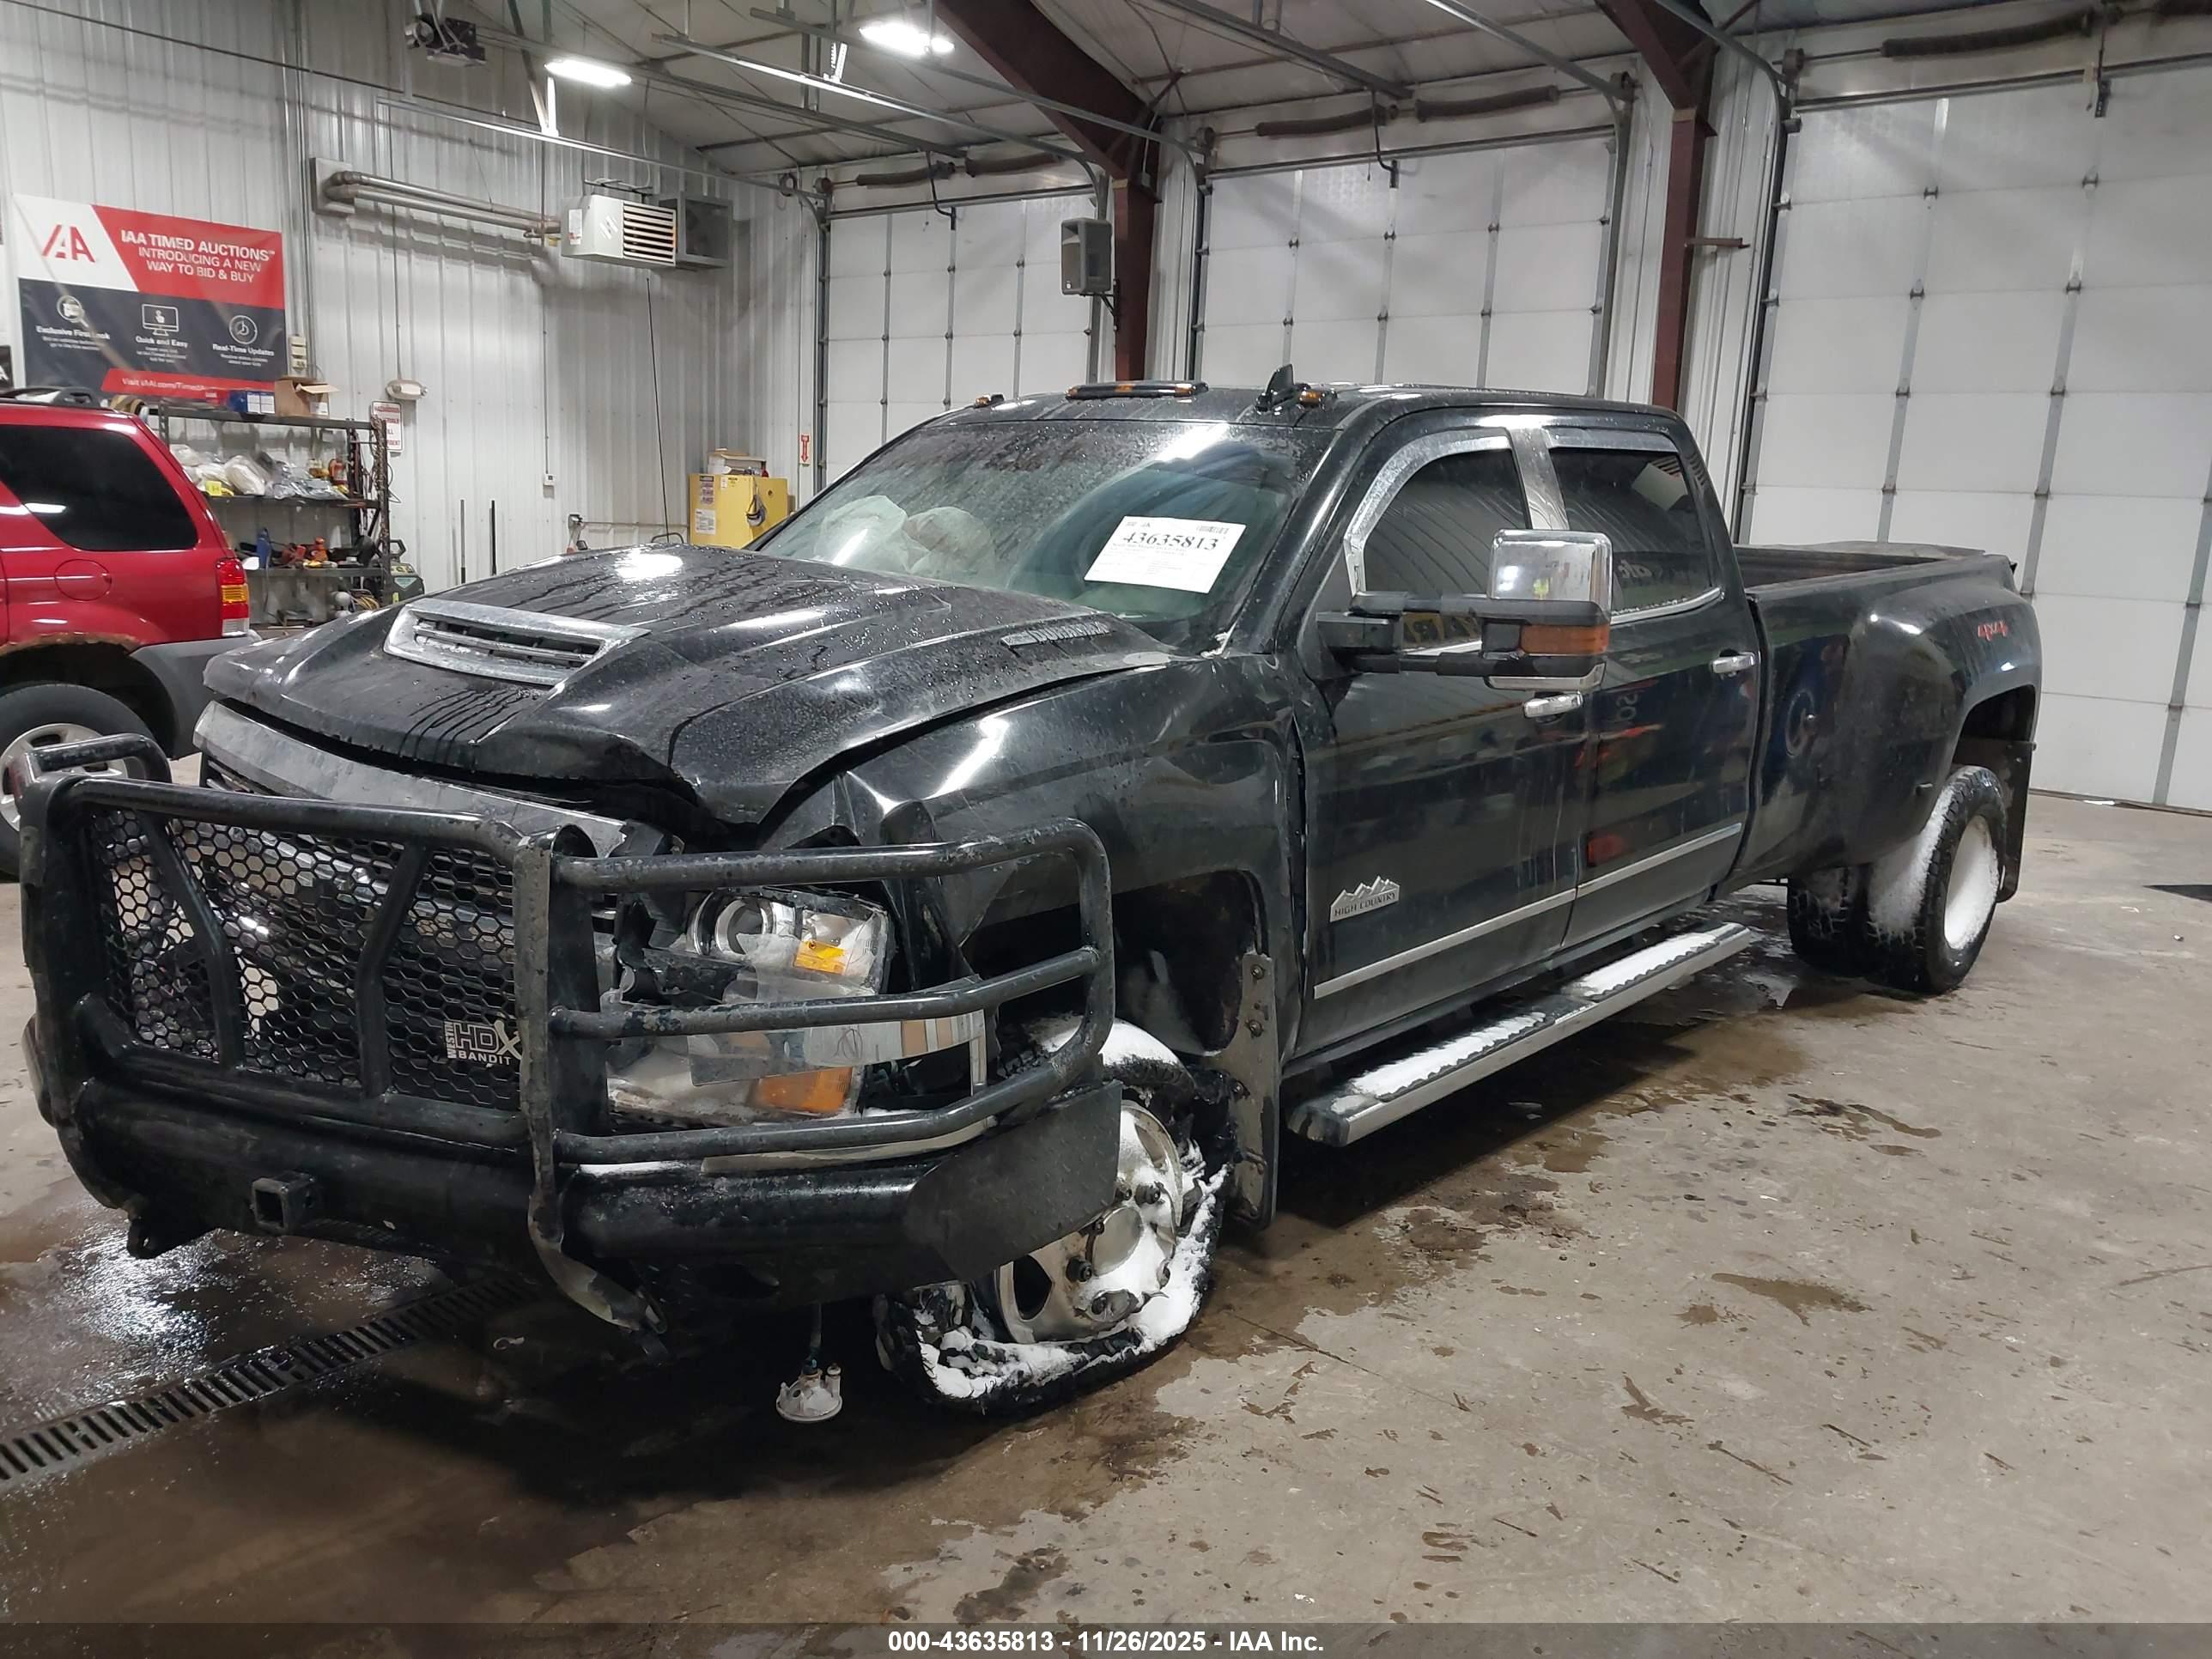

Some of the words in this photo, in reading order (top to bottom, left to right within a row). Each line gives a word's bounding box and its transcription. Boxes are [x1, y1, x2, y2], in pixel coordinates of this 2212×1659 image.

[120, 229, 147, 246] IAA
[149, 234, 195, 252] TIMED
[138, 246, 221, 268] INTRODUCING
[222, 258, 232, 269] A
[234, 261, 262, 272] NEW
[146, 260, 174, 272] WAY
[177, 264, 194, 275] TO
[197, 267, 216, 278] BID
[218, 270, 228, 280] &
[230, 270, 255, 283] BUY
[1122, 532, 1219, 551] 43635813
[1334, 903, 1358, 917] HIGH
[1359, 892, 1396, 909] COUNTRY
[444, 1020, 457, 1059] WESTIN
[458, 1050, 512, 1066] BANDIT
